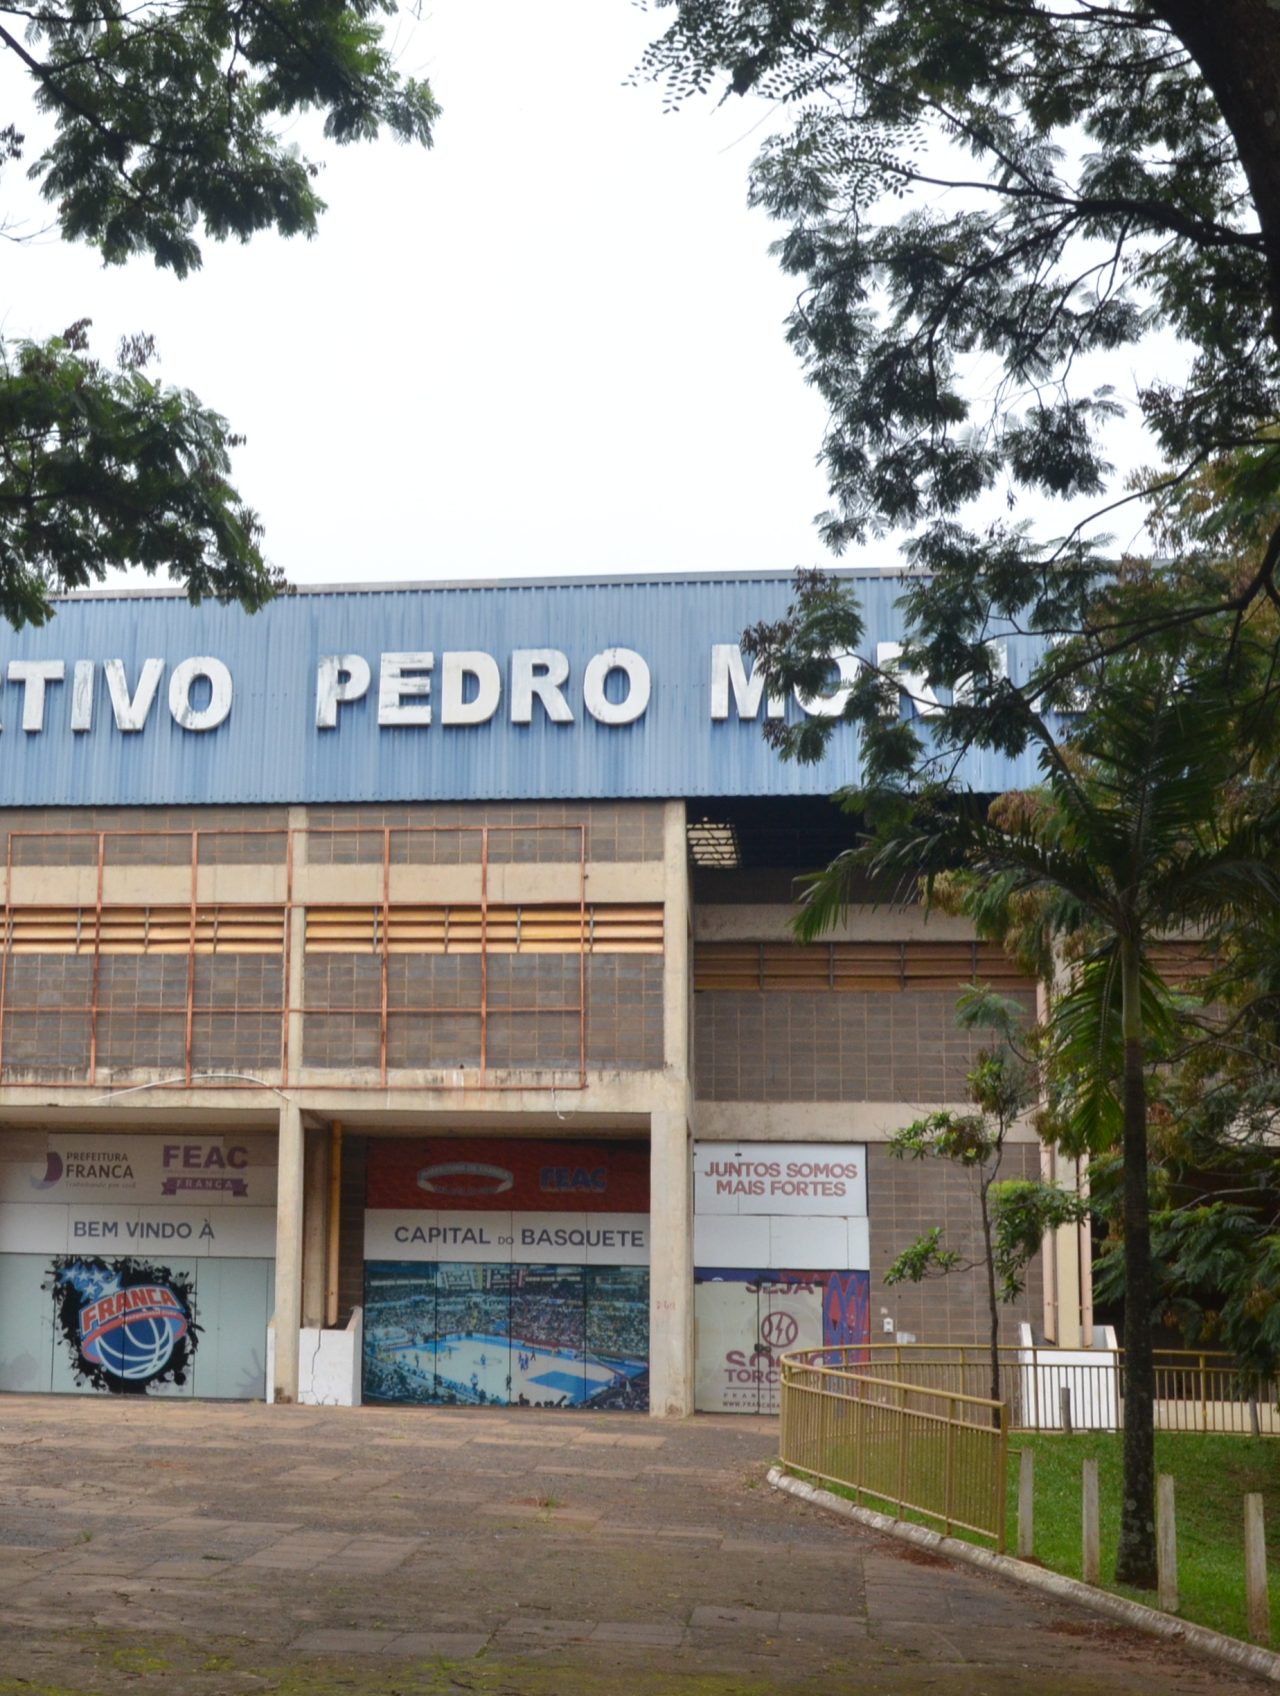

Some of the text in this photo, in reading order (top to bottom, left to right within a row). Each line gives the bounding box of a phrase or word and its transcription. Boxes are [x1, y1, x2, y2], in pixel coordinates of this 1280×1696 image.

[315, 647, 652, 728] PEDRO
[66, 1151, 129, 1163] PREFEITURA
[162, 1144, 249, 1170] FEAC
[65, 1163, 134, 1180] FRANCA
[540, 1167, 607, 1189] FEAC
[704, 1161, 858, 1179] JUNTOS SOMOS
[175, 1179, 234, 1190] FRANCA
[716, 1180, 847, 1197] MAIS FORTES
[74, 1221, 118, 1238] BEM
[126, 1222, 192, 1239] VINDO
[394, 1226, 644, 1248] CAPITAL DO BASQUETE
[81, 1286, 180, 1335] FRANCA
[724, 1369, 780, 1384] TORC
